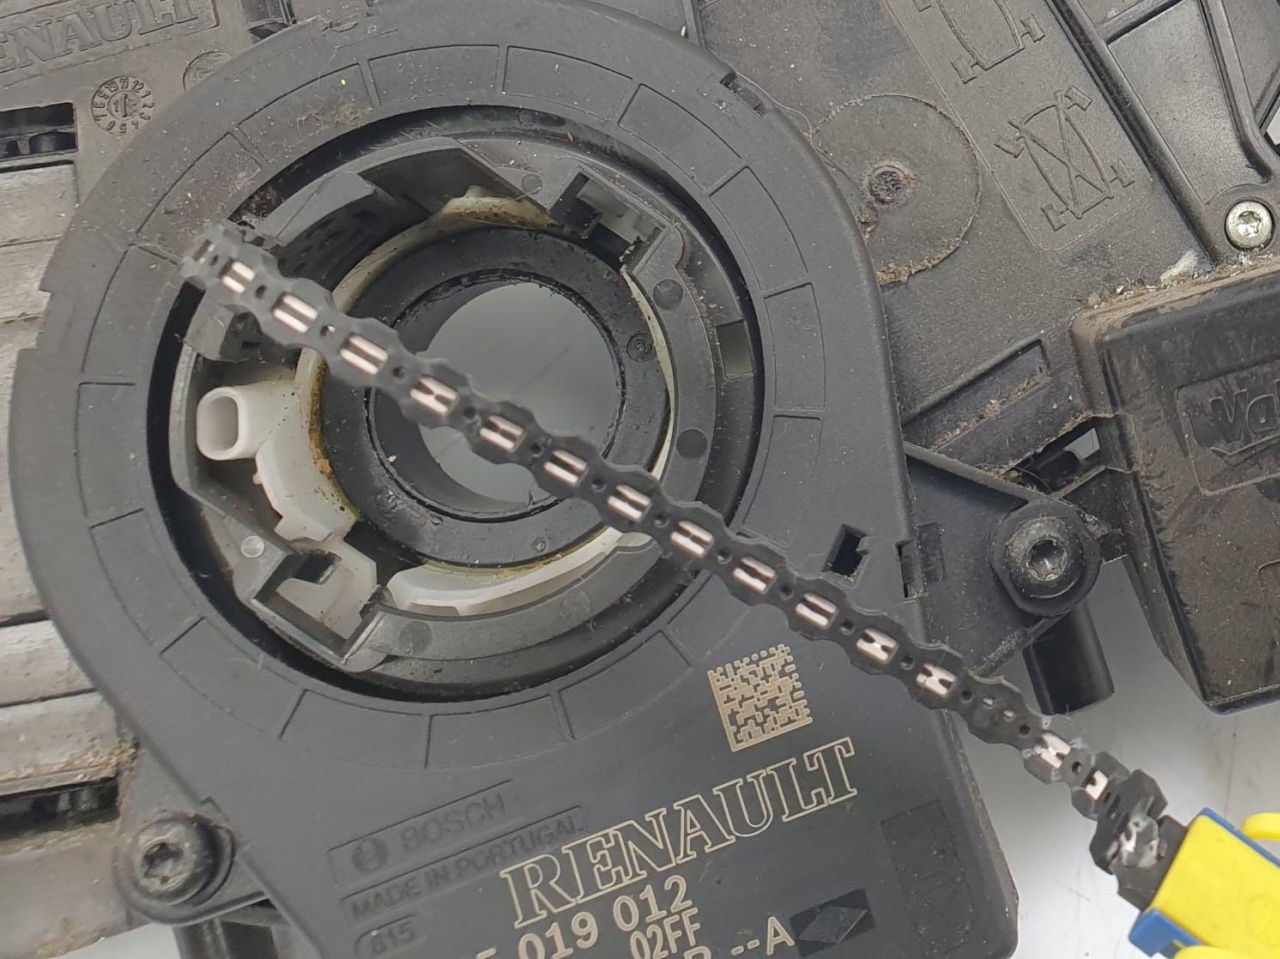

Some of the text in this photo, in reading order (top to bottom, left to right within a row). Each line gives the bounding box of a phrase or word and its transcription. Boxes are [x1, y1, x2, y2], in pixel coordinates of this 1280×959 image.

[400, 792, 508, 852] BOSCH
[499, 736, 858, 929] RENAULT
[351, 875, 423, 920] MADE
[423, 863, 450, 890] IN
[516, 874, 693, 959] 019 012
[629, 907, 701, 959] 02FF
